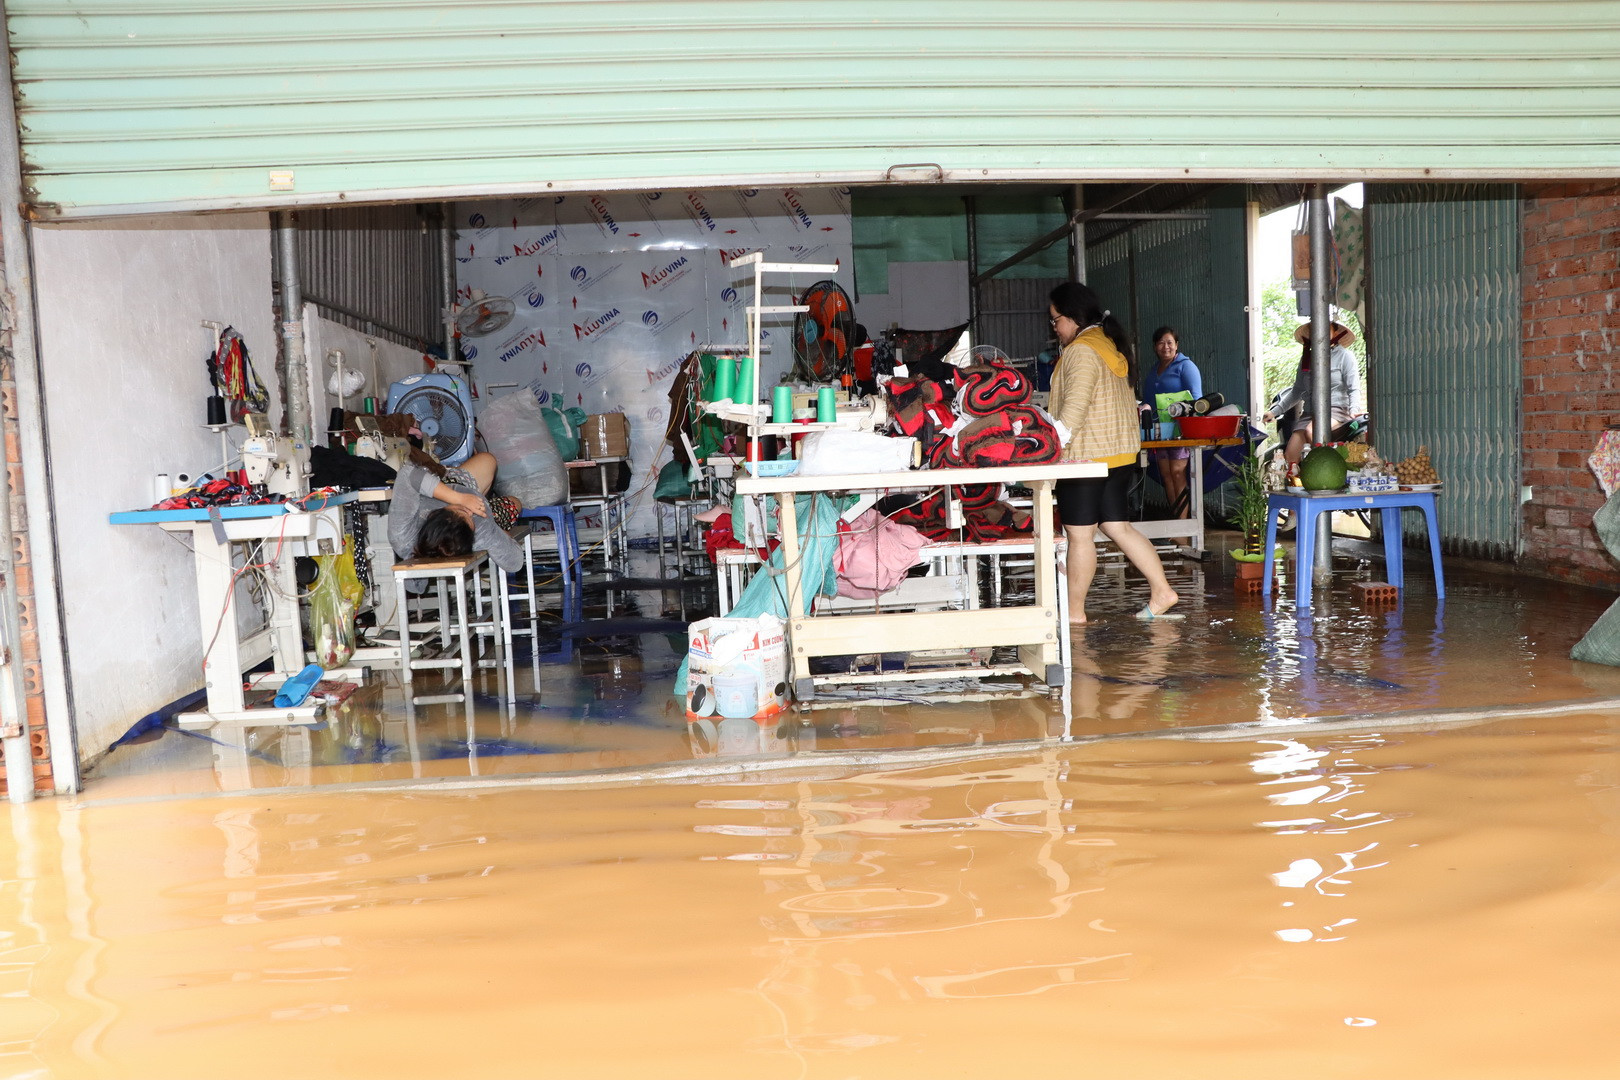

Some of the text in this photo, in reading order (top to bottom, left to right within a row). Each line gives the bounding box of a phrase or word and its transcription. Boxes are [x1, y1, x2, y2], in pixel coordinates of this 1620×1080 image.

[641, 256, 688, 290] ALUVINA
[573, 308, 620, 341] ALUVINA
[499, 328, 547, 362] ALUVINA
